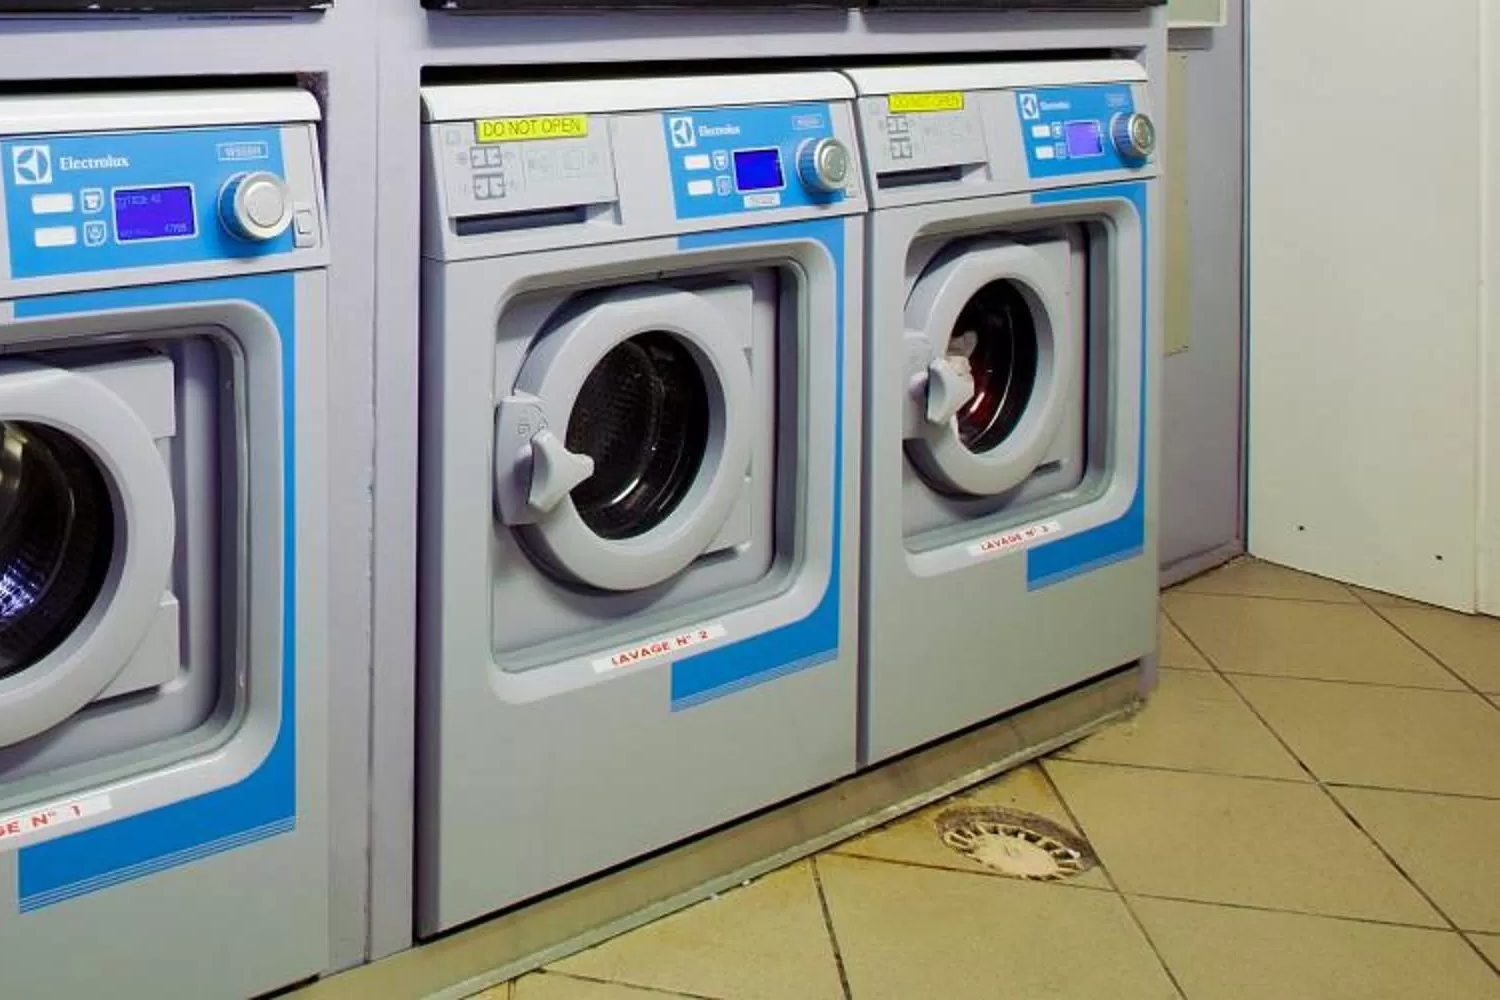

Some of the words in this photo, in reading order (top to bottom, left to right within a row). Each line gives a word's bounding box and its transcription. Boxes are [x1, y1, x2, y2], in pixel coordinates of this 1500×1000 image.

[483, 121, 501, 137] DO
[508, 120, 537, 136] NOT
[541, 117, 581, 133] OPEN
[59, 153, 130, 171] Electrolux
[611, 642, 670, 665] LAVAGE
[71, 805, 82, 818] 1
